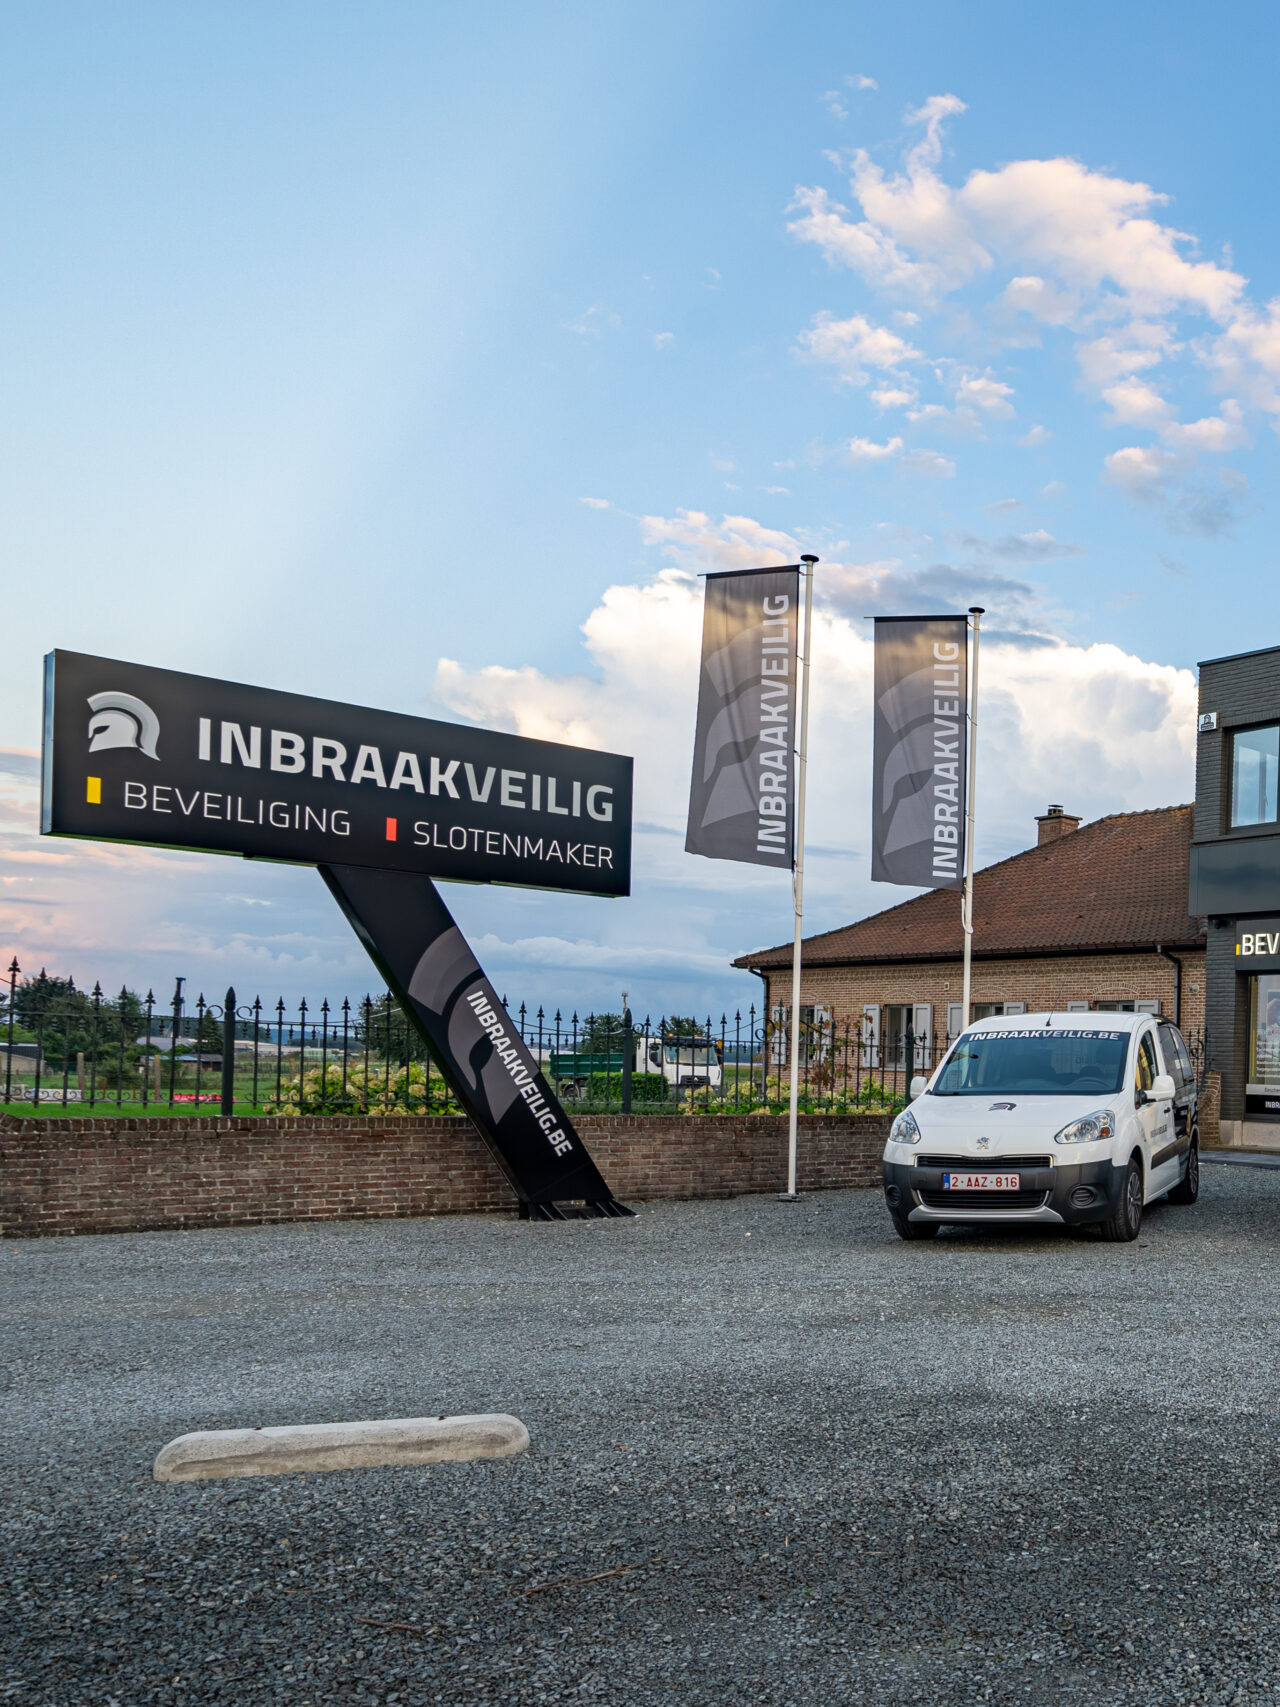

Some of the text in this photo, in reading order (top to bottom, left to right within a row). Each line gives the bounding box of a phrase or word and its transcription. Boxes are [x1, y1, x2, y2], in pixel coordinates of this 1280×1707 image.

[757, 594, 789, 855] INBRAAKVEILIG
[932, 641, 960, 879] INBRAAKVEILIG
[124, 781, 350, 835] BEVEILIGING
[198, 716, 614, 822] INBRAAKVEILIG
[414, 821, 614, 869] SLOTENMAKER
[466, 990, 573, 1157] INBRAAKVEILIG.BE
[969, 1029, 1121, 1042] INBRAAKVEILIG.BE
[952, 1176, 1017, 1188] 2-AAZ-816
